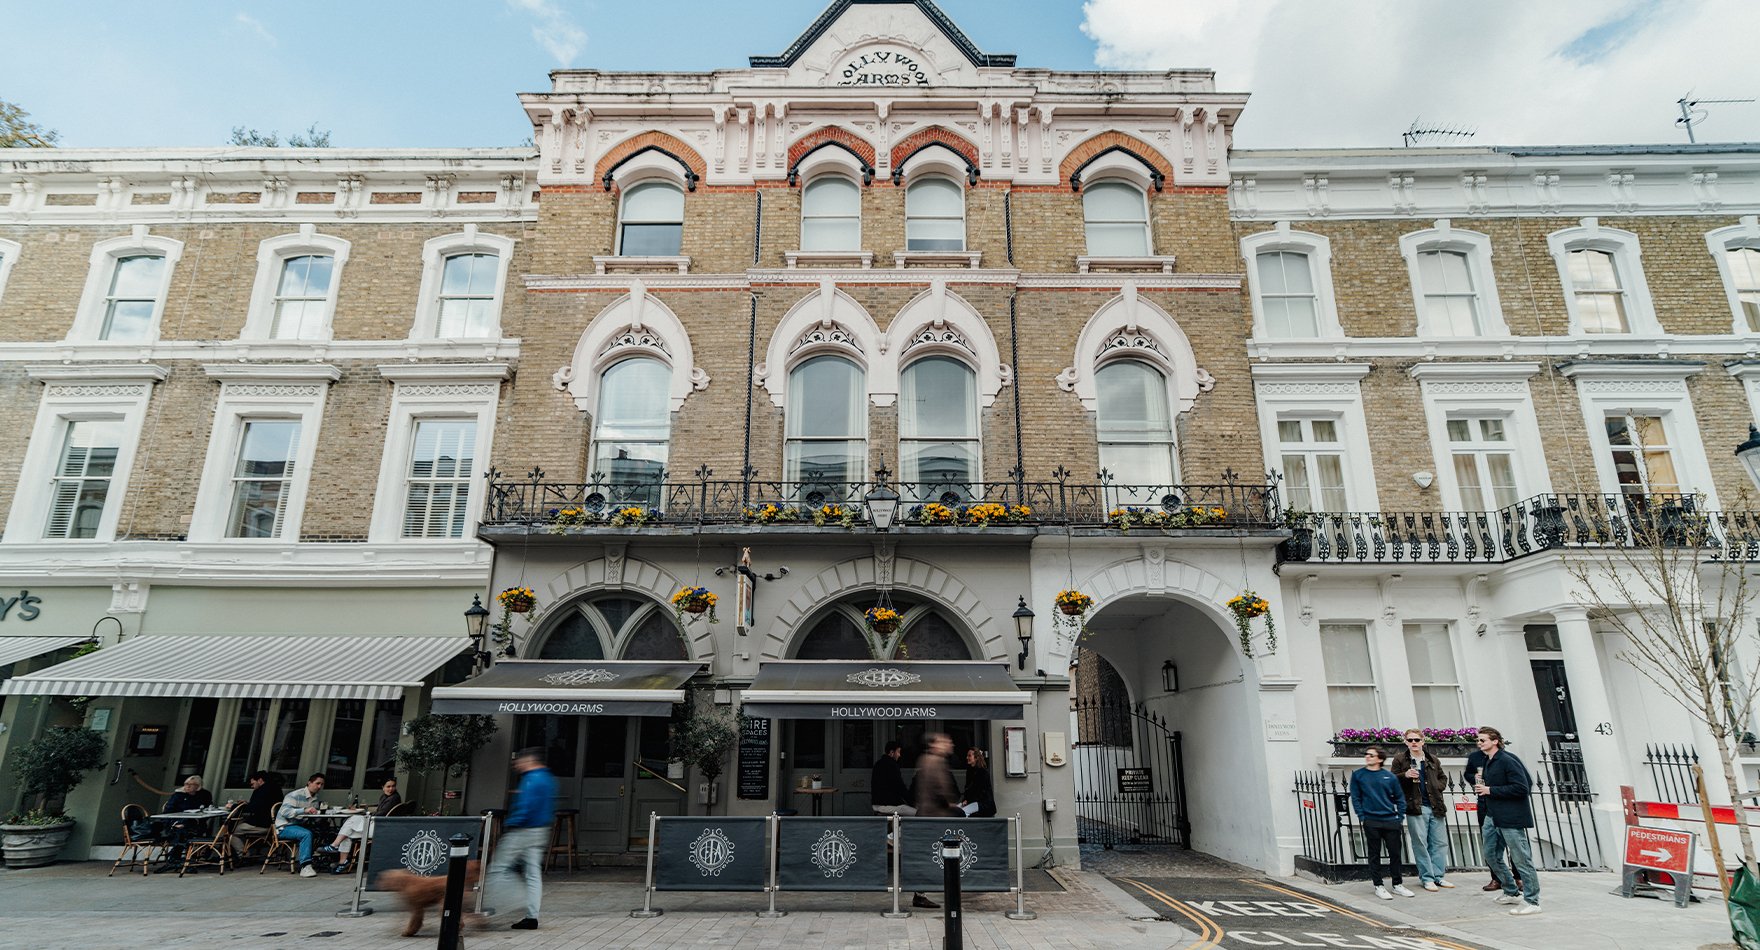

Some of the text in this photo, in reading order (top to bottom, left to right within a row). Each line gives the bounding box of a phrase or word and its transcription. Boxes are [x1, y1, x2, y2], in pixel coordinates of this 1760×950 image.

[852, 73, 911, 86] ARMS
[499, 703, 604, 713] HOLLYWOOD ARMS
[831, 707, 937, 717] HOLLYWOOD ARMS
[744, 719, 768, 730] IRE
[1594, 722, 1613, 736] 43
[1631, 830, 1688, 844] PEDESTRIANS
[1185, 901, 1332, 918] KEEP
[1226, 931, 1455, 950] CLEAR
